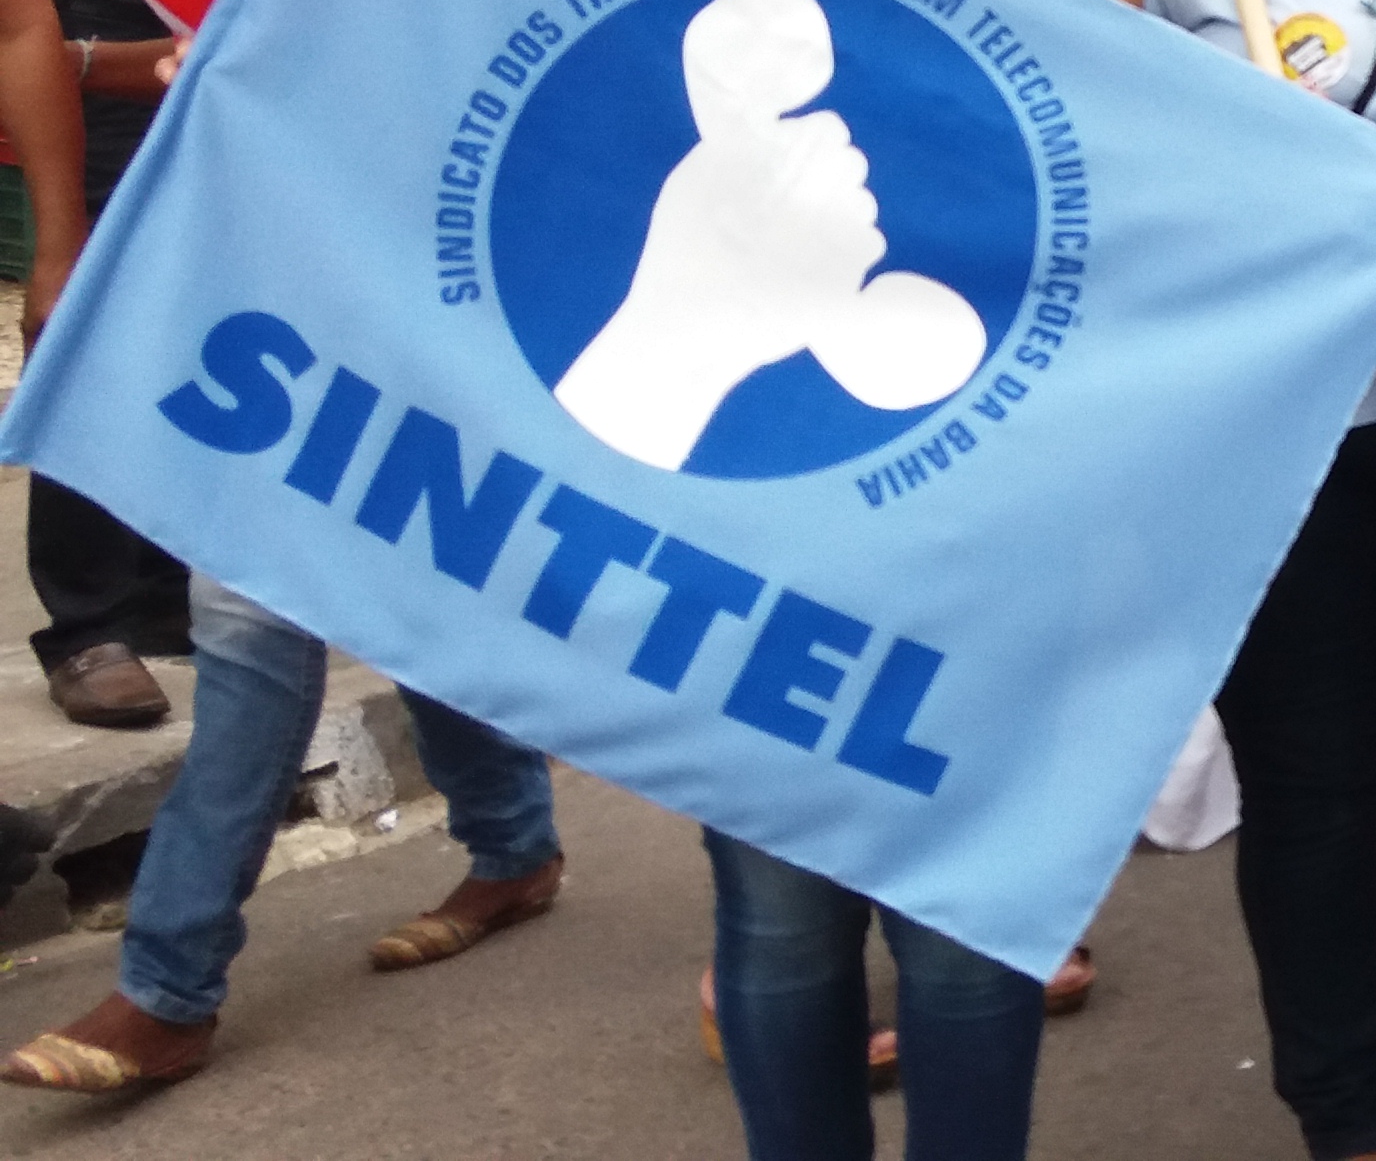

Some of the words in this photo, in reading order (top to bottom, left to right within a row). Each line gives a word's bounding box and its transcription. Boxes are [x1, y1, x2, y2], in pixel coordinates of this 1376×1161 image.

[488, 9, 564, 88] DOS
[435, 89, 508, 306] SINDICATO
[968, 8, 1091, 370] TELECOMUNICAÇÕES
[857, 418, 978, 509] BAHIA
[972, 372, 1029, 422] DA
[156, 310, 950, 797] SINTTEL
